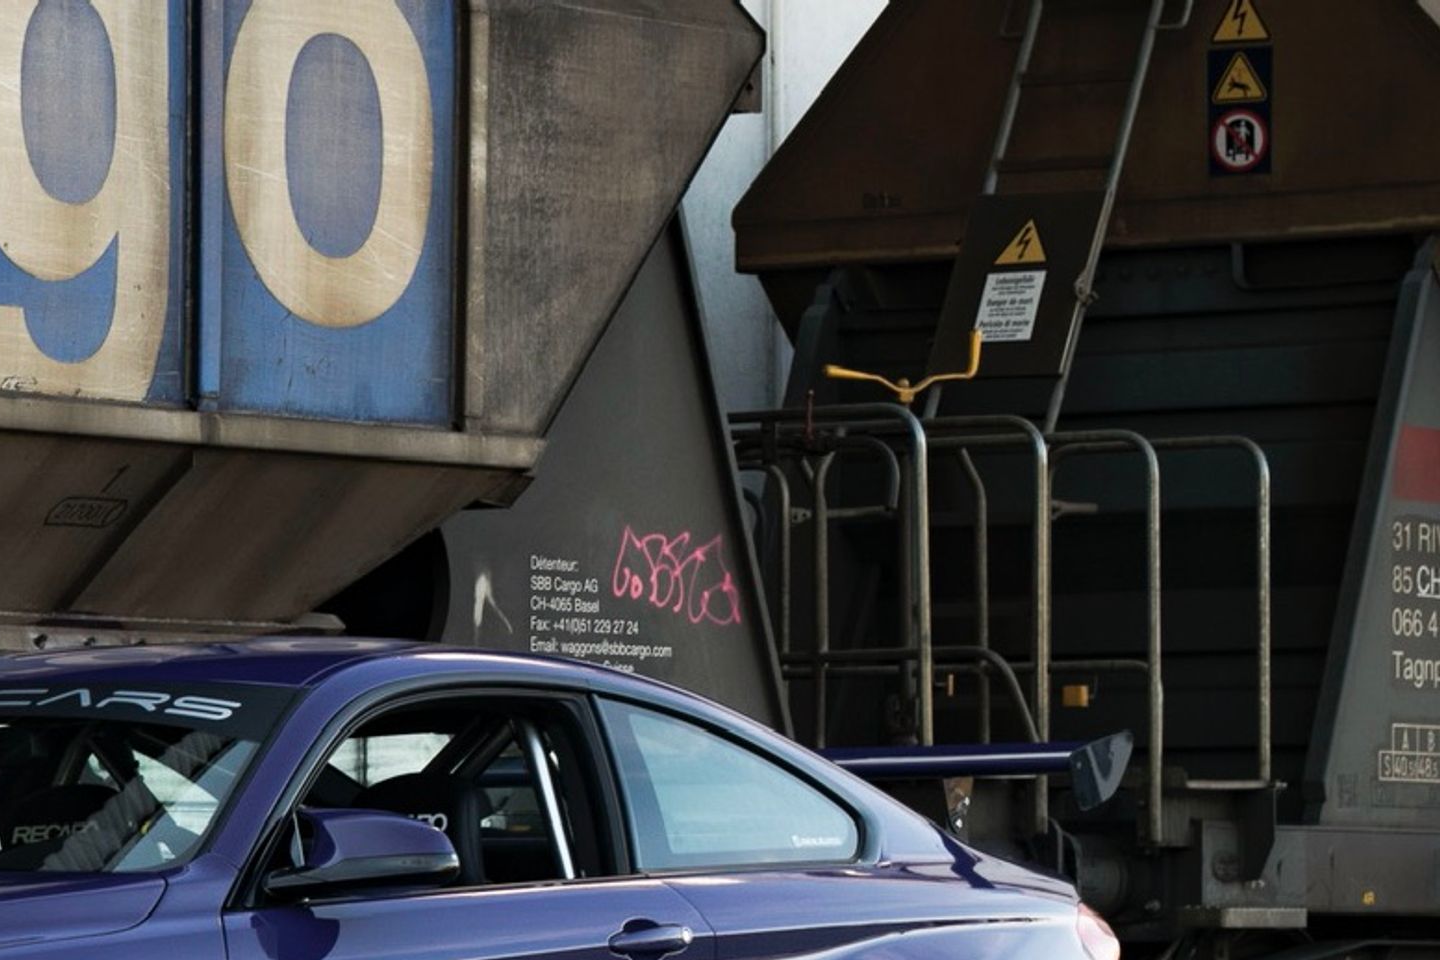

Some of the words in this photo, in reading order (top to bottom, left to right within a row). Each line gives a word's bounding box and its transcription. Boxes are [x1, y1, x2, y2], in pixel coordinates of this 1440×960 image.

[1391, 521, 1411, 551] 31
[530, 575, 552, 591] SBB
[554, 576, 583, 596] Cargo
[583, 578, 599, 593] AG
[1391, 565, 1413, 594] 85
[574, 597, 600, 613] Basel
[613, 619, 625, 635] 27
[626, 620, 639, 635] 24
[1391, 608, 1423, 638] 066
[530, 636, 558, 653] Email:
